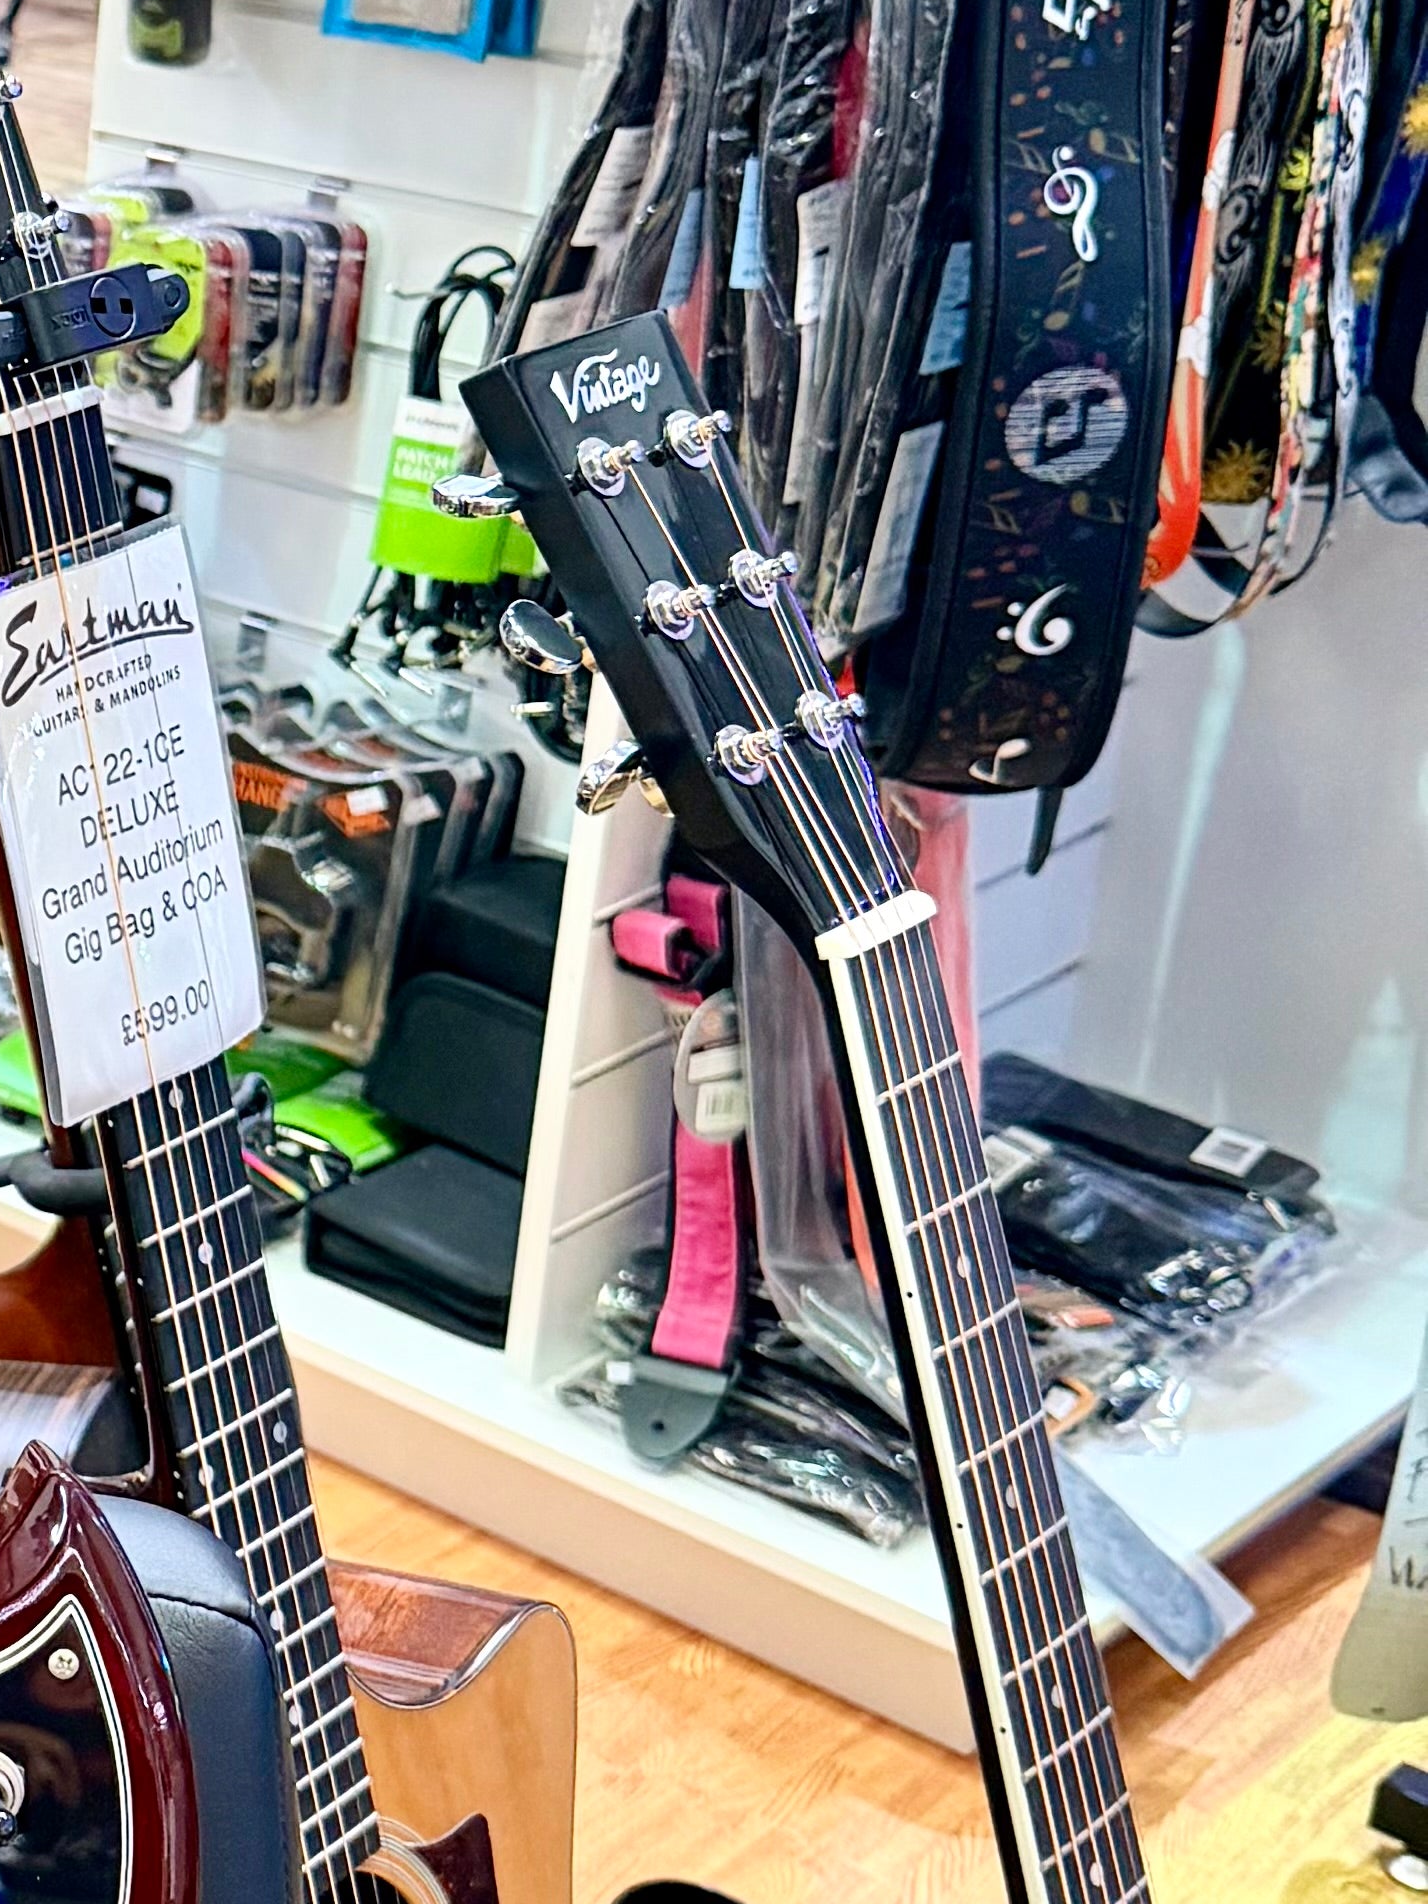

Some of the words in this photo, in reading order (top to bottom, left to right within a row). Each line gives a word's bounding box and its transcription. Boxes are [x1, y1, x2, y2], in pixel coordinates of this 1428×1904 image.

[550, 348, 660, 424] Vintage
[394, 446, 450, 472] PATCH
[1, 595, 194, 708] Eastman
[94, 698, 106, 714] &
[109, 664, 182, 708] MANDOLINS
[58, 723, 186, 807] AC22-1CE
[80, 780, 180, 848] DELUXE
[41, 863, 109, 921] Grand
[116, 818, 225, 884] Auditorium
[64, 927, 103, 965] Gig
[105, 906, 156, 948] Bag
[162, 890, 179, 923] &
[181, 864, 229, 911] COA
[120, 978, 212, 1048] £599.00
